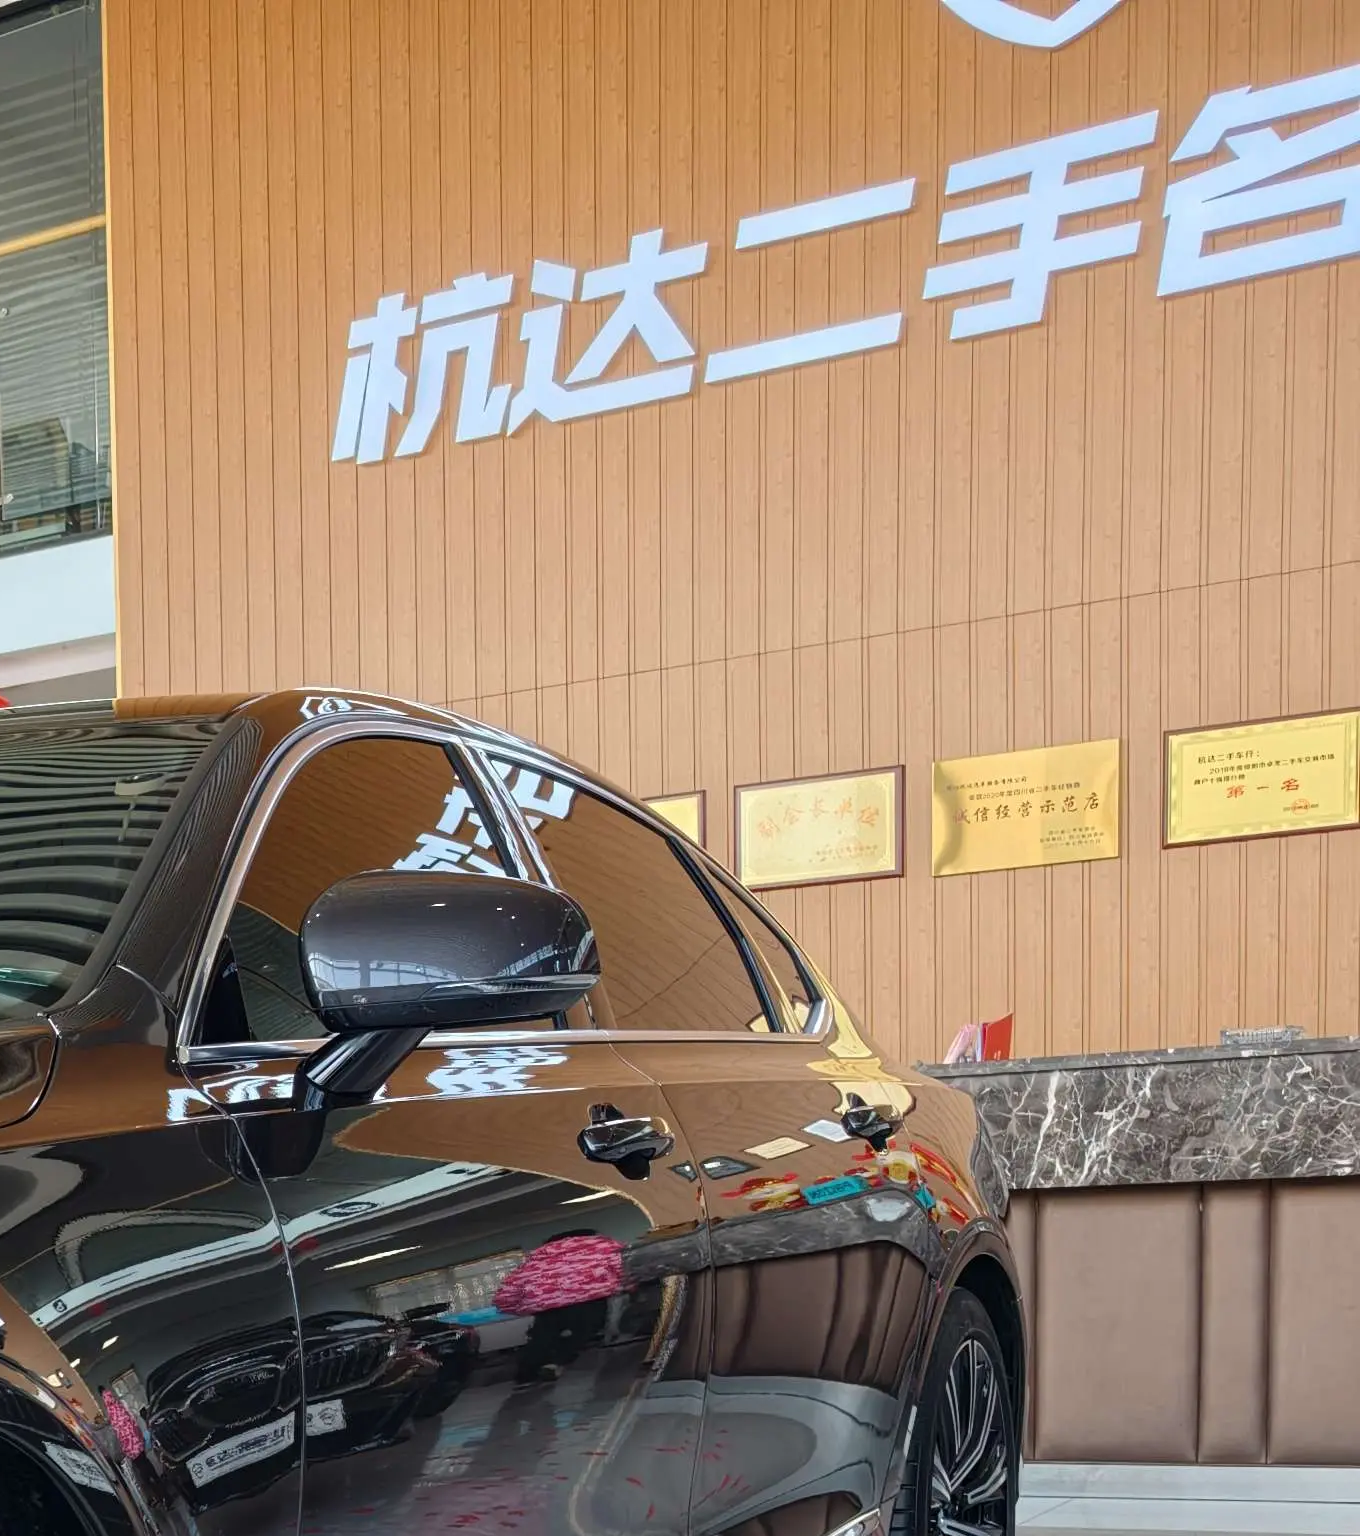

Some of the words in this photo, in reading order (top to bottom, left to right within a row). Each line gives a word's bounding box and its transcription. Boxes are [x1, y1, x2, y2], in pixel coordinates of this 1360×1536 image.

[332, 64, 1360, 464] 杭达二手名
